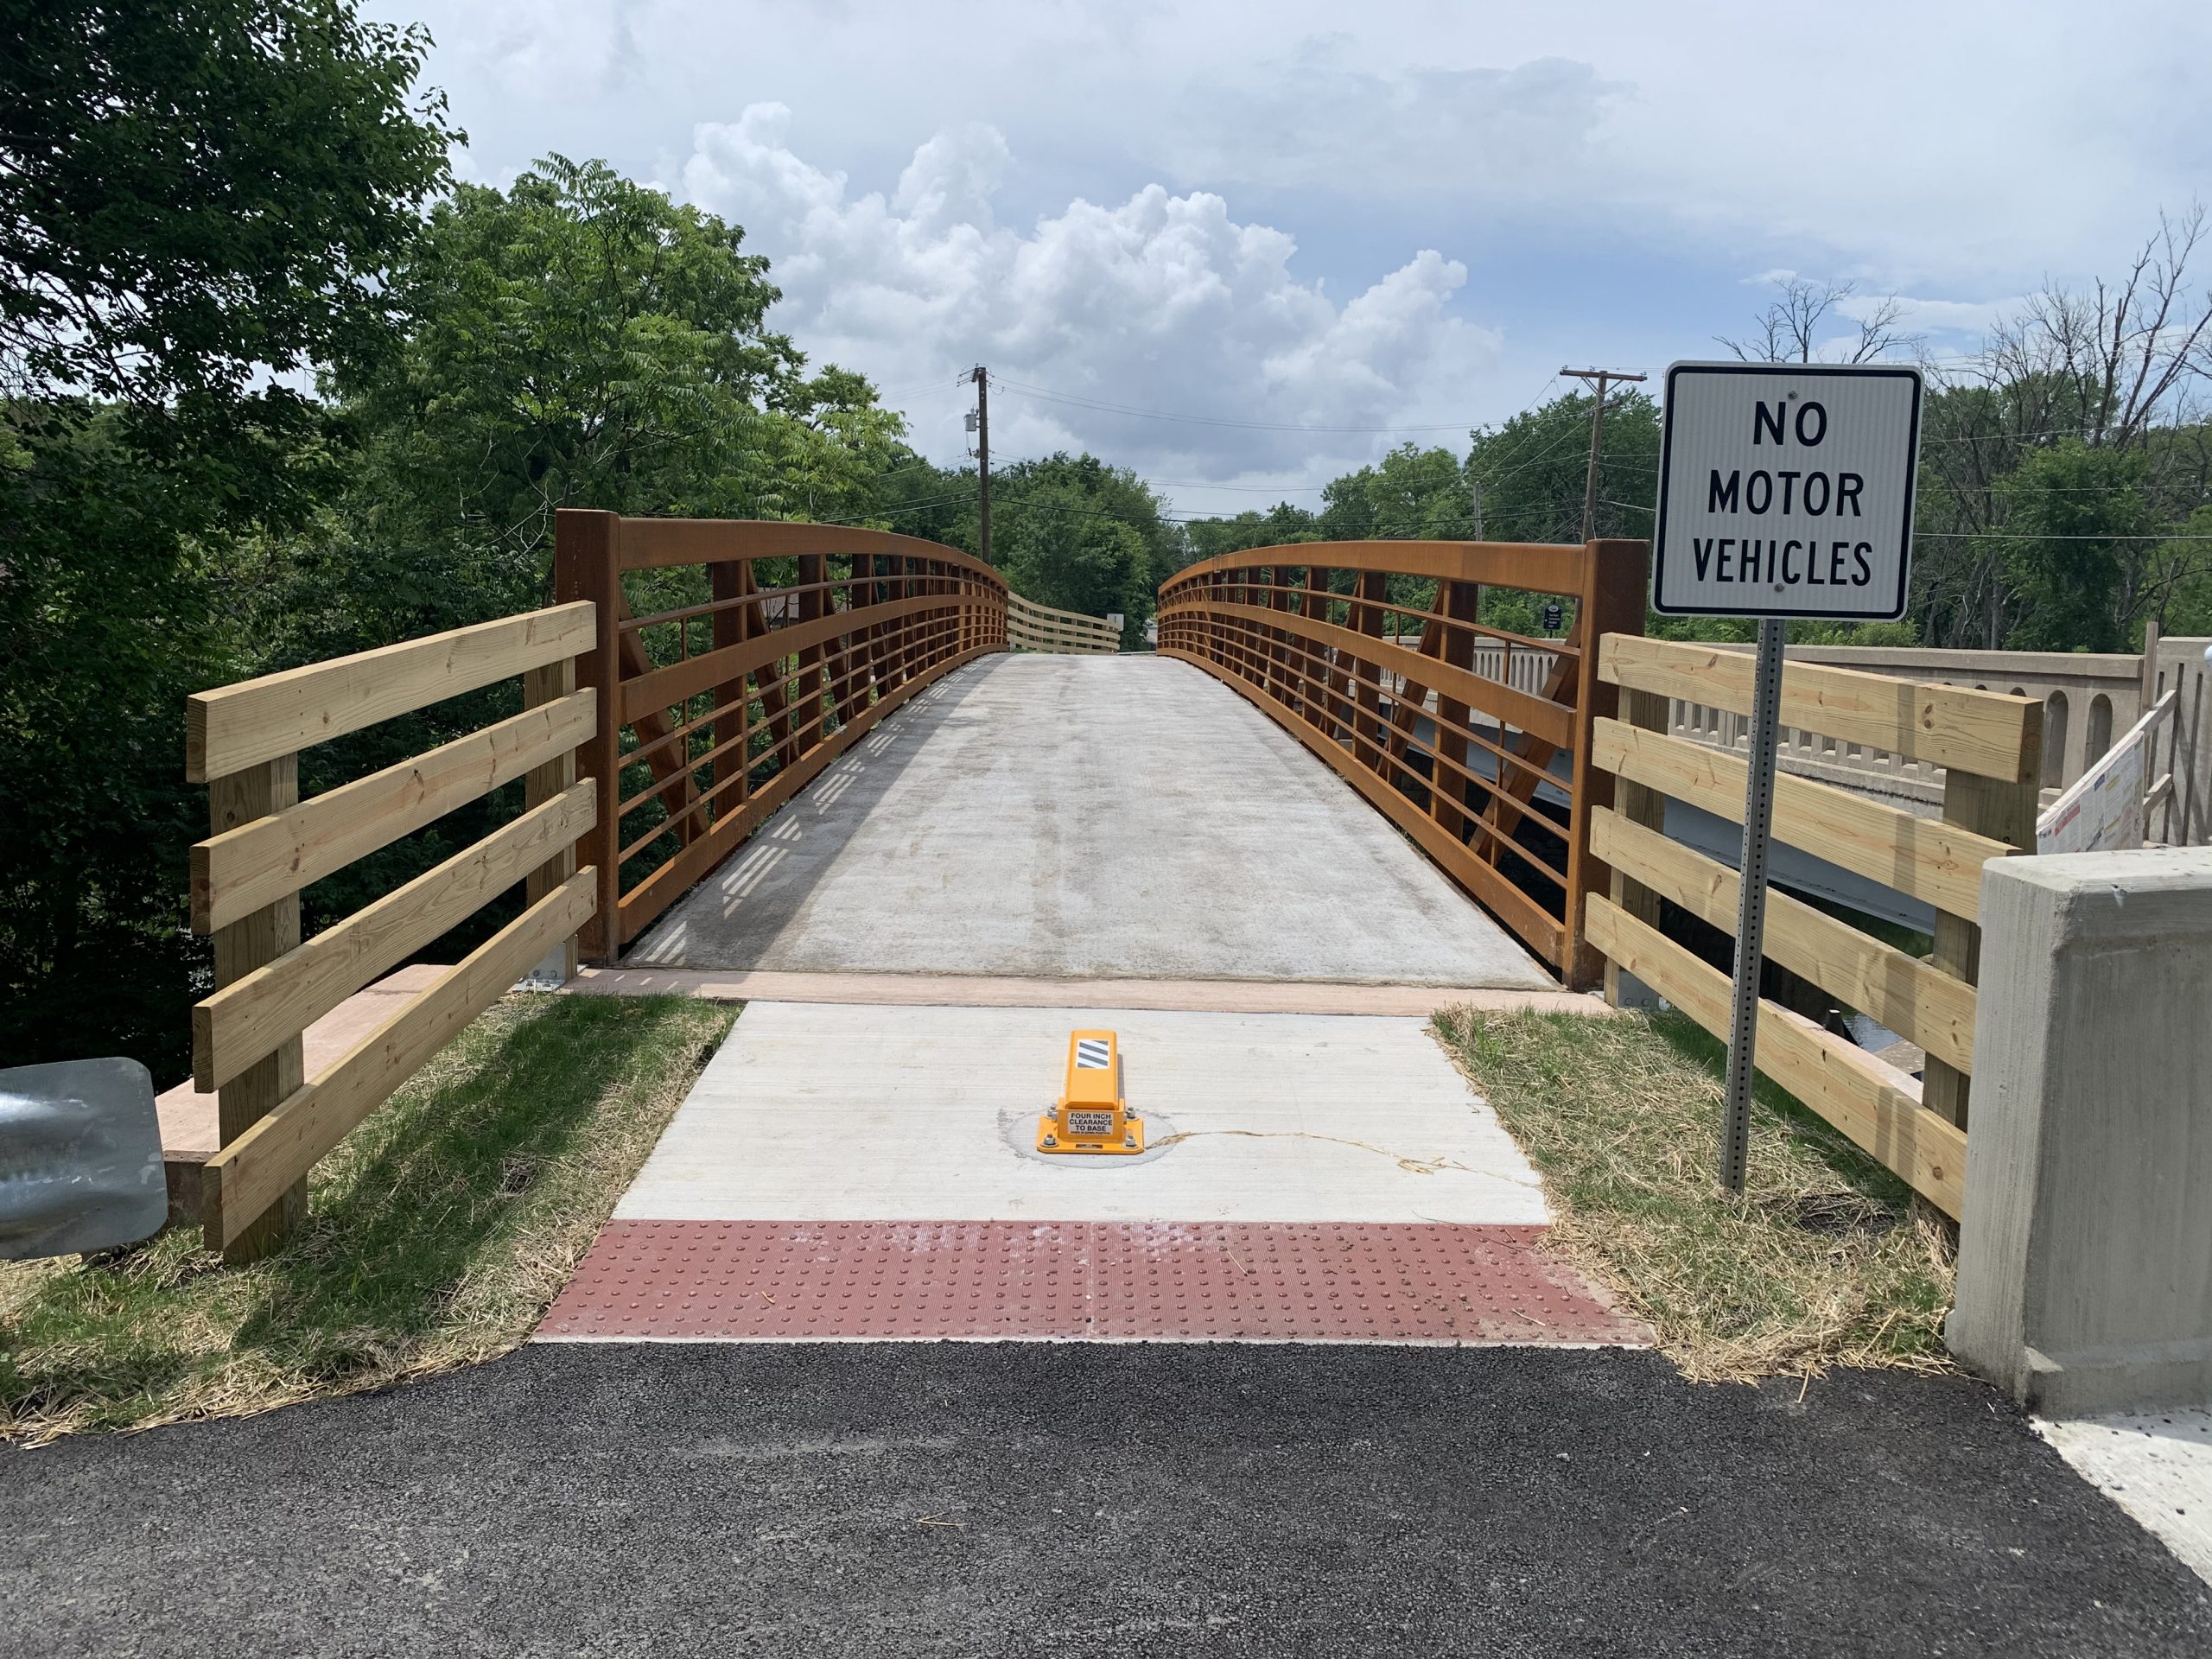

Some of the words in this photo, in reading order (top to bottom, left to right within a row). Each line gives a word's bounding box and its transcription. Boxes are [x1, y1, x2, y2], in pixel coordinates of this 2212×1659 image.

[1753, 401, 1827, 447] NO
[1708, 469, 1864, 517] MOTOR
[1693, 537, 1873, 587] VEHICLES
